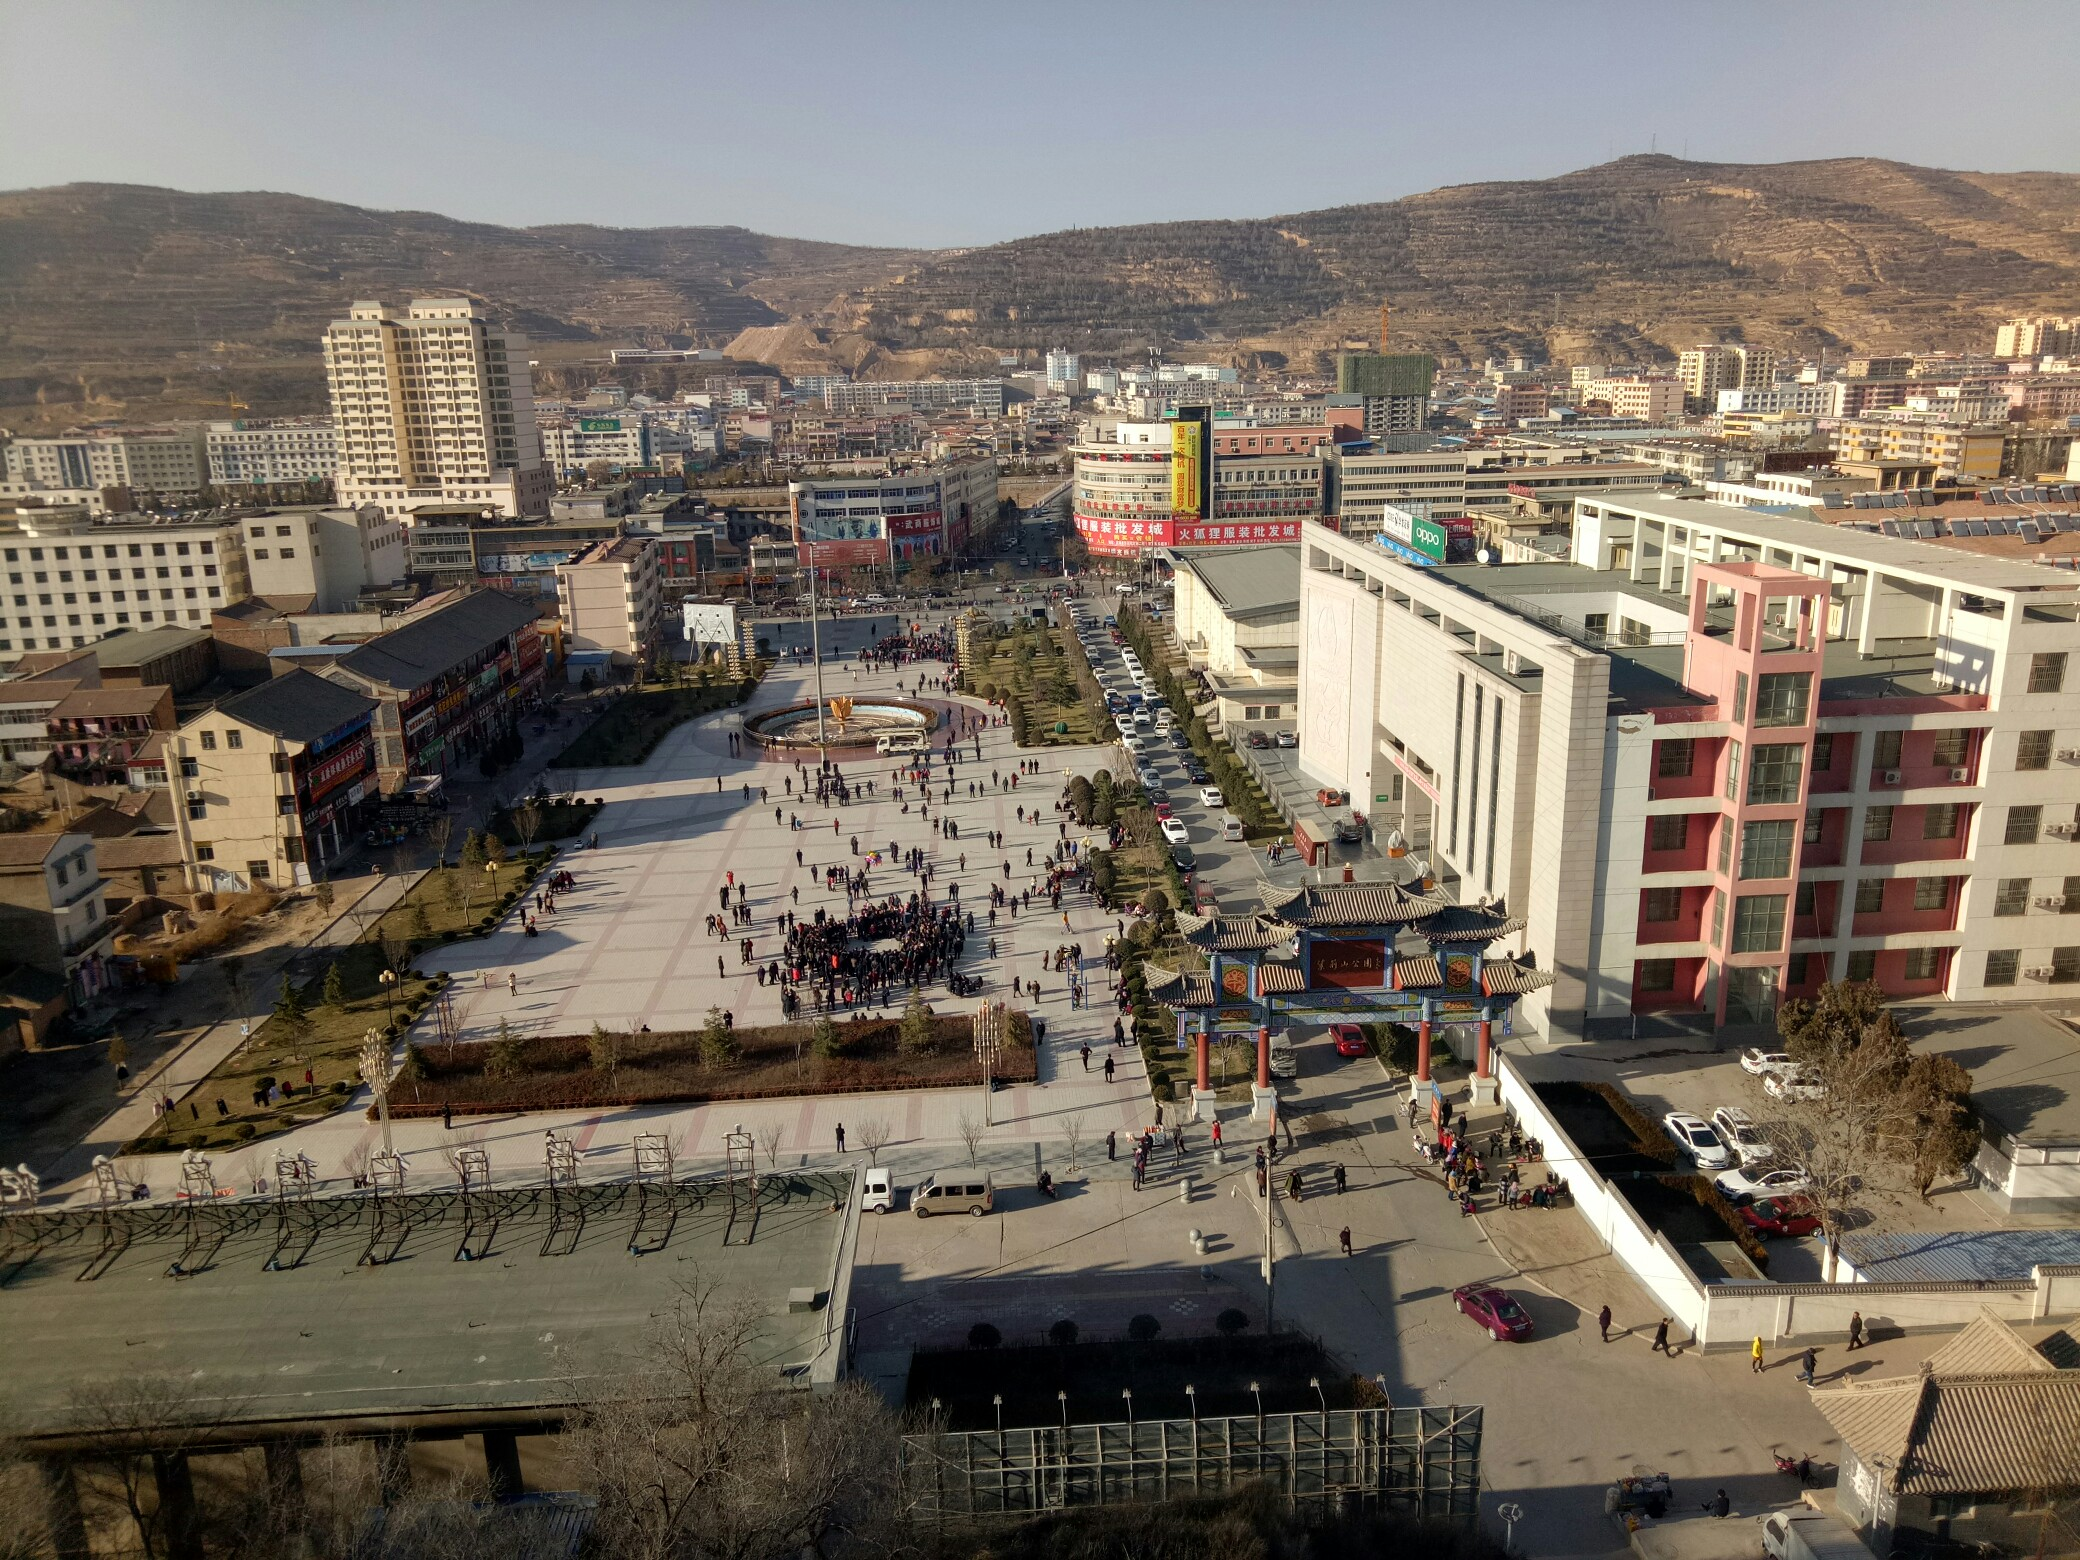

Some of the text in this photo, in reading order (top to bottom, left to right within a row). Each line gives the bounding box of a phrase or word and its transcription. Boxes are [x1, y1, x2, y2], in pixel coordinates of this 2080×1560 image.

[1180, 524, 1295, 540] 火狐狸服装批发城
[1416, 527, 1439, 546] oppo
